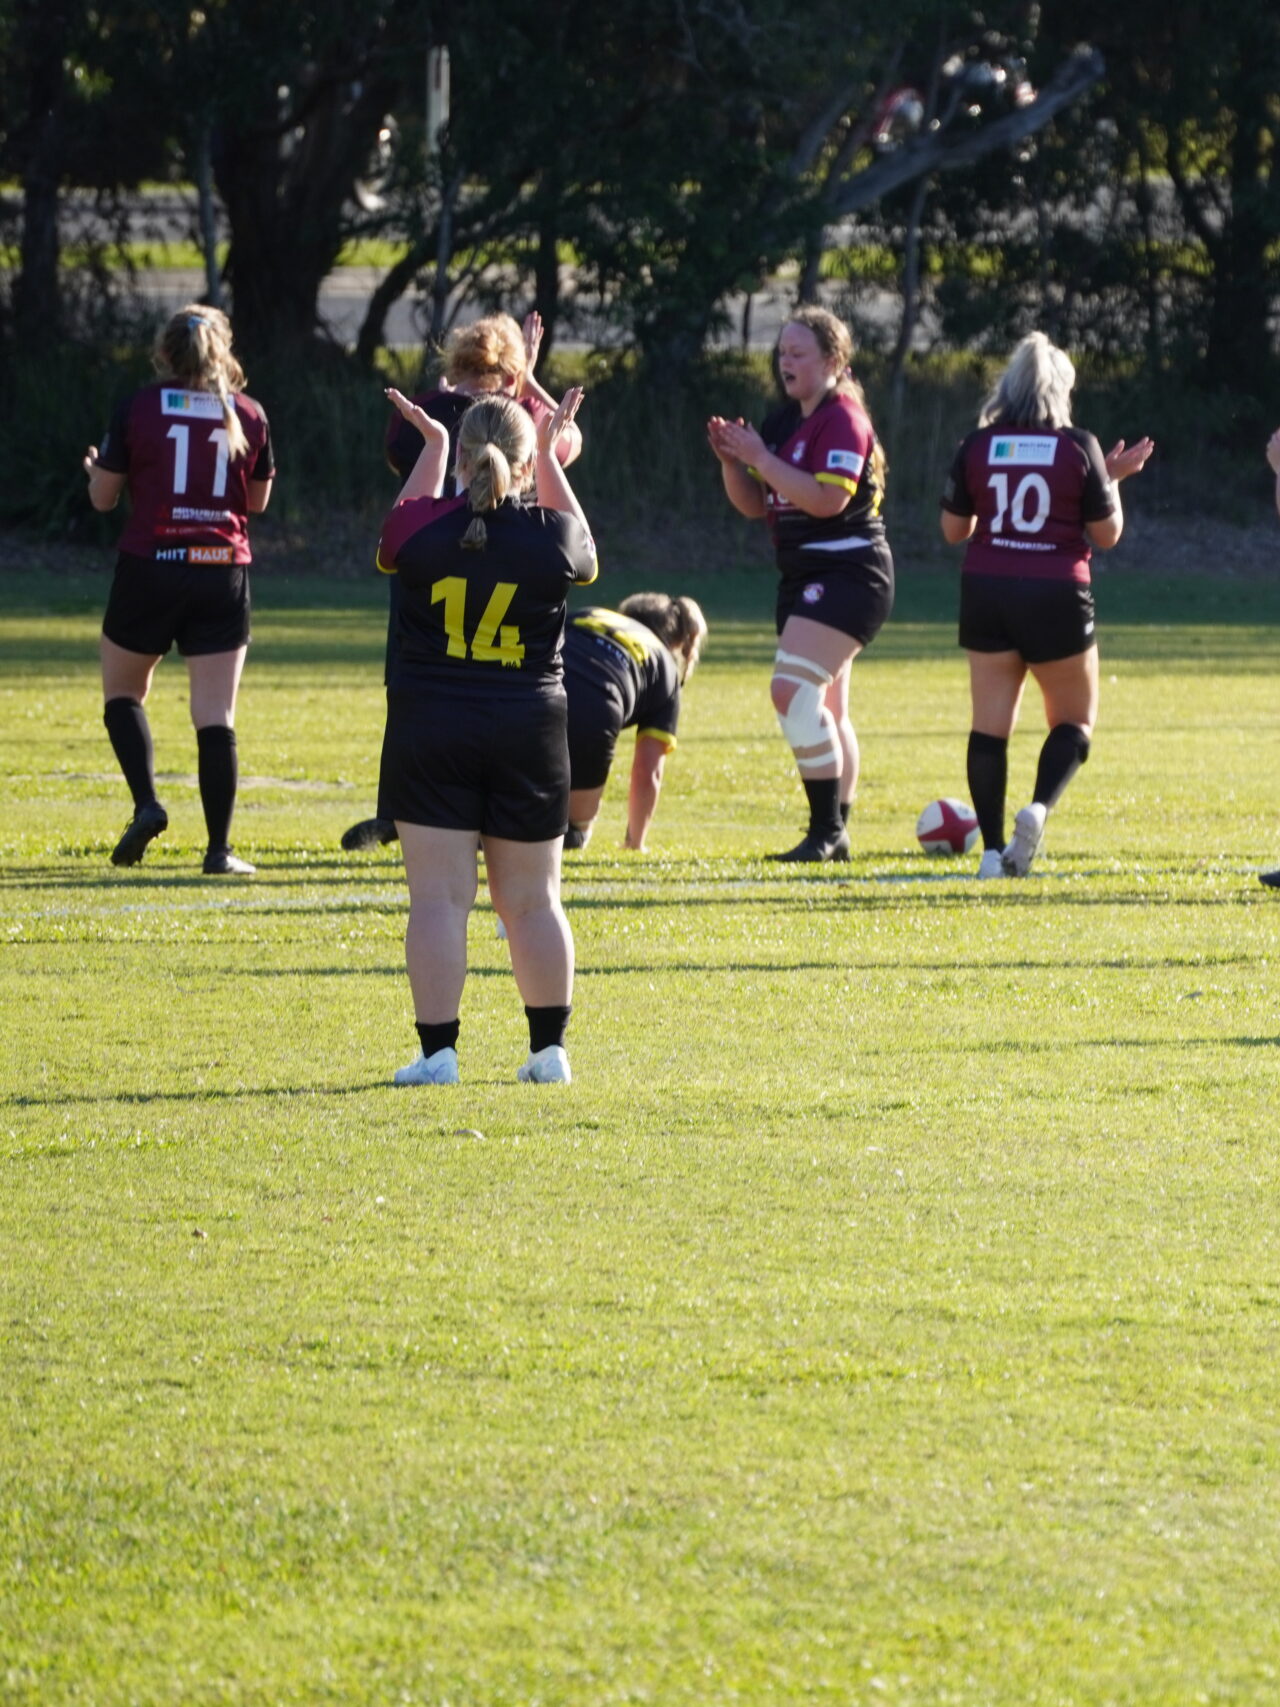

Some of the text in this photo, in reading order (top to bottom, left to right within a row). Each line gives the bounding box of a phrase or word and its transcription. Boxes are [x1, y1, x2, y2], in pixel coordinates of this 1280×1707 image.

[166, 423, 229, 497] 11
[987, 472, 1051, 533] 10
[156, 548, 229, 561] HIIT HAUS
[430, 575, 526, 669] 14
